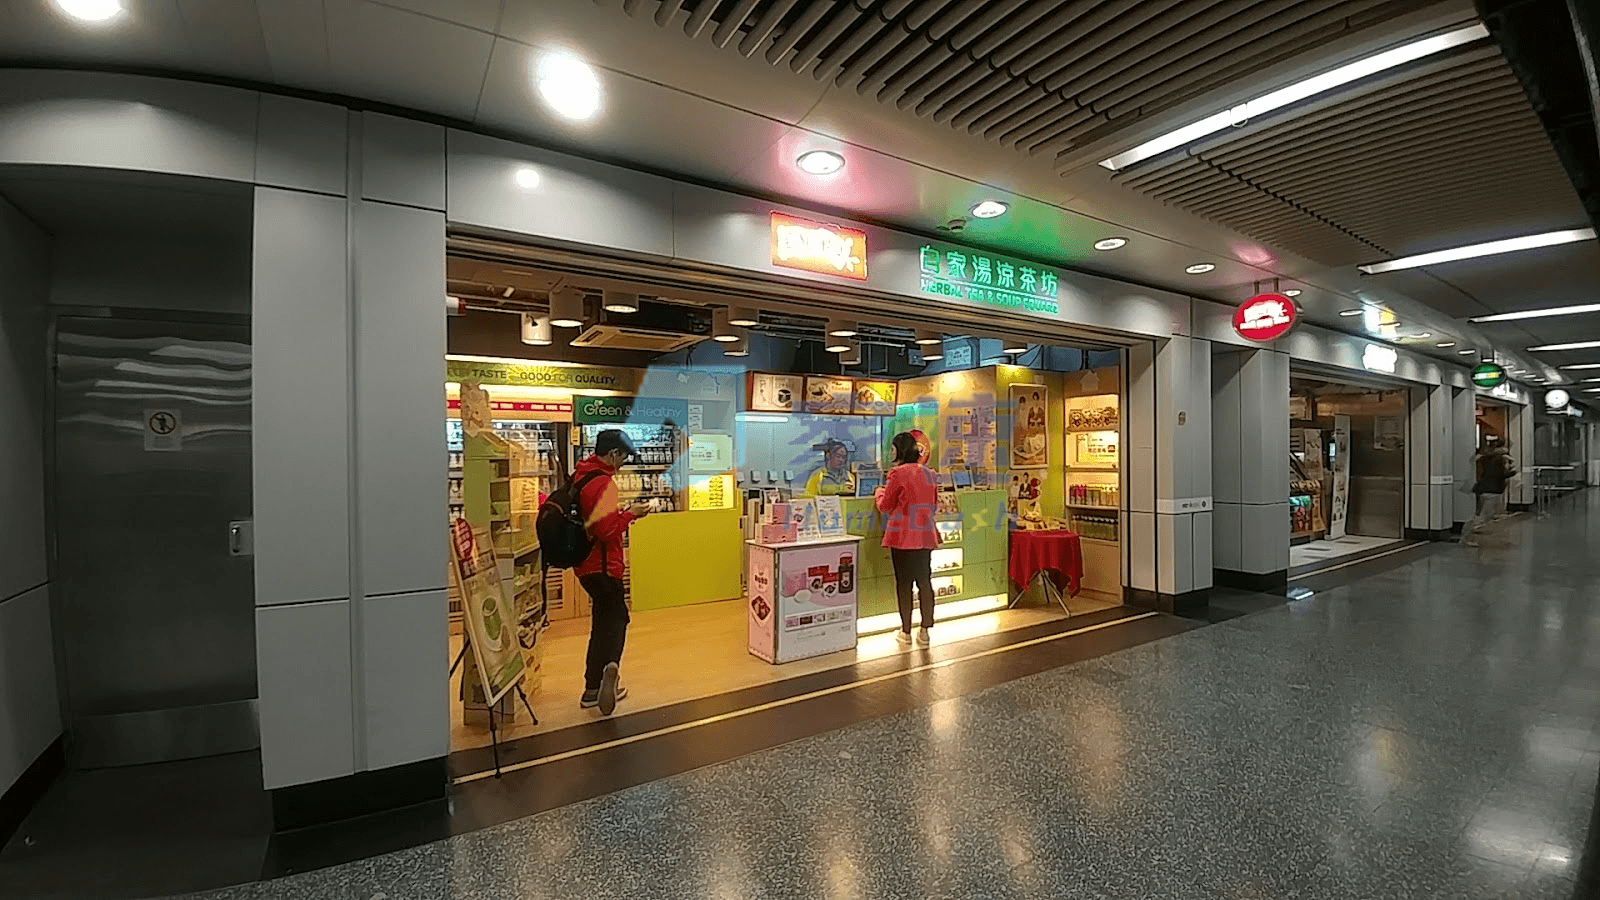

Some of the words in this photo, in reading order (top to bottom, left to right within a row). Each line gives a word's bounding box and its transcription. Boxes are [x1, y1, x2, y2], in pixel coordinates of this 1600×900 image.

[920, 245, 1058, 298] 自家湯涼茶坊
[920, 278, 963, 298] HERBAL
[966, 286, 985, 302] TEA
[986, 290, 995, 304] &
[996, 292, 1021, 307] SOUP
[1022, 297, 1059, 315] SQUARE
[472, 369, 508, 379] TASTE
[520, 371, 552, 382] GOOD
[575, 374, 617, 385] QUALITY
[584, 403, 623, 416] Green
[624, 405, 635, 416] &
